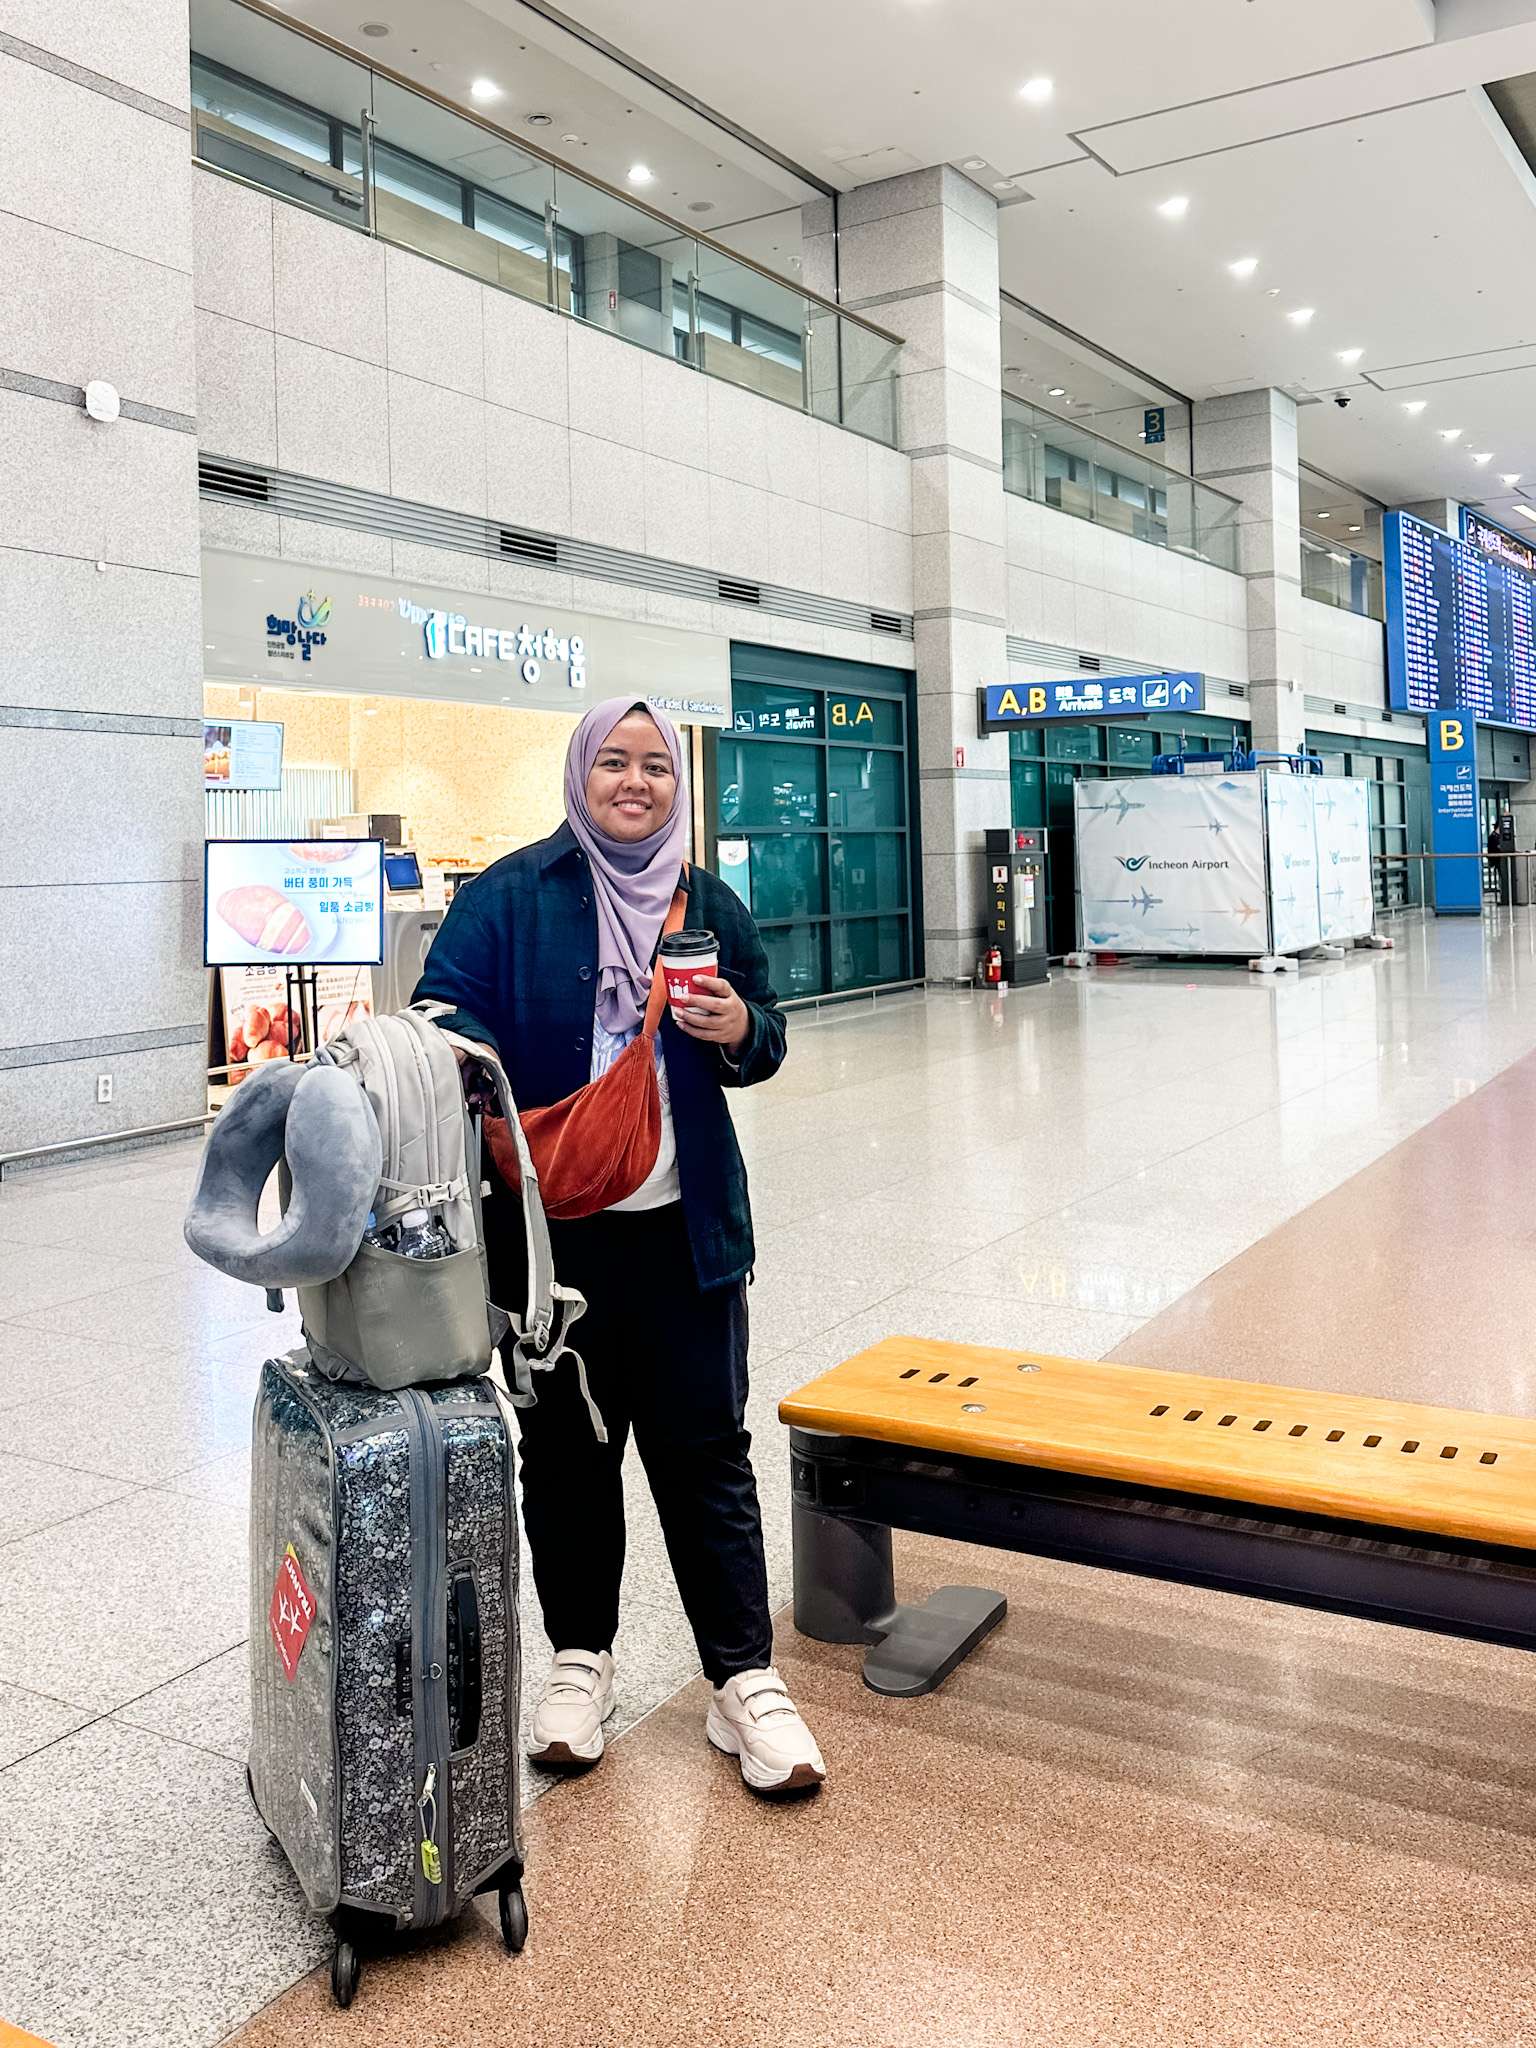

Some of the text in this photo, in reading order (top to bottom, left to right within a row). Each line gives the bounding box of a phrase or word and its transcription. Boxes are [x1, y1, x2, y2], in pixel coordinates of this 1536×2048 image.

[1148, 412, 1160, 433] 3
[266, 614, 327, 661] 희망 날다
[447, 623, 516, 661] CAFE
[998, 687, 1047, 716] A,B
[1058, 697, 1104, 712] Arrivals
[1108, 686, 1137, 704] 도착
[1440, 720, 1464, 751] B
[1148, 860, 1229, 871] Incheon Airport
[284, 877, 353, 889] 버터 풍미 가득
[320, 901, 375, 913] 일품 소금빵
[285, 1557, 312, 1620] TRANSIT
